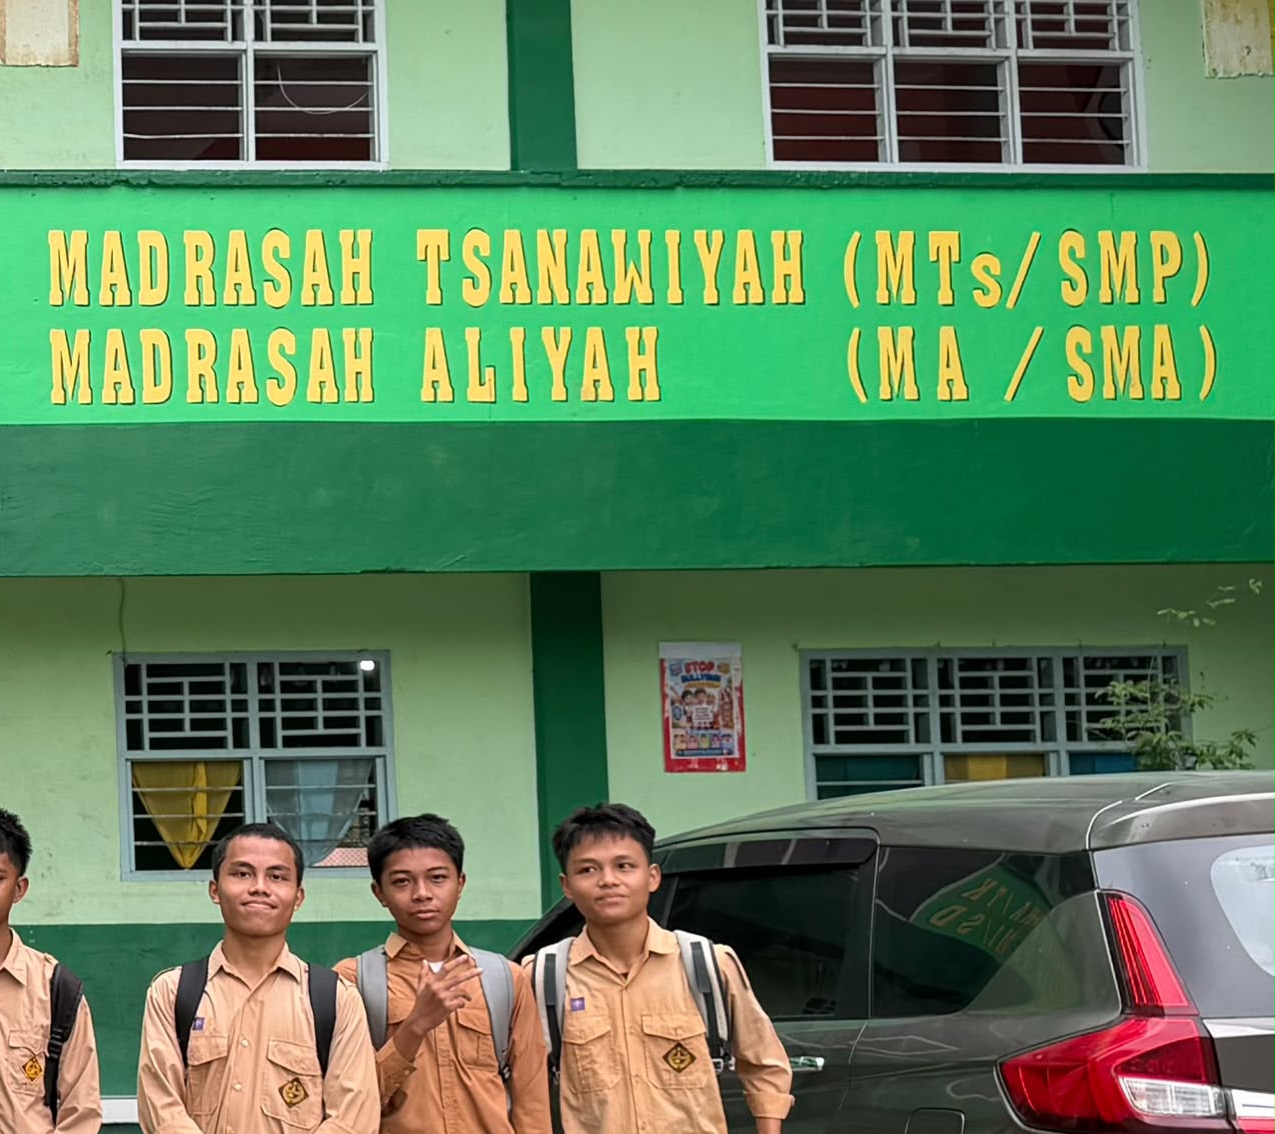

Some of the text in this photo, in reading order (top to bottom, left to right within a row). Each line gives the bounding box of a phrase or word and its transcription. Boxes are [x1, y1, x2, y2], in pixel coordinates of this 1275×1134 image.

[48, 229, 373, 307] MADRASAH
[417, 228, 805, 307] TSANAWIYAH
[50, 328, 373, 406] MADRASAH
[421, 327, 661, 403] ALIYAH
[684, 661, 715, 674] STOP
